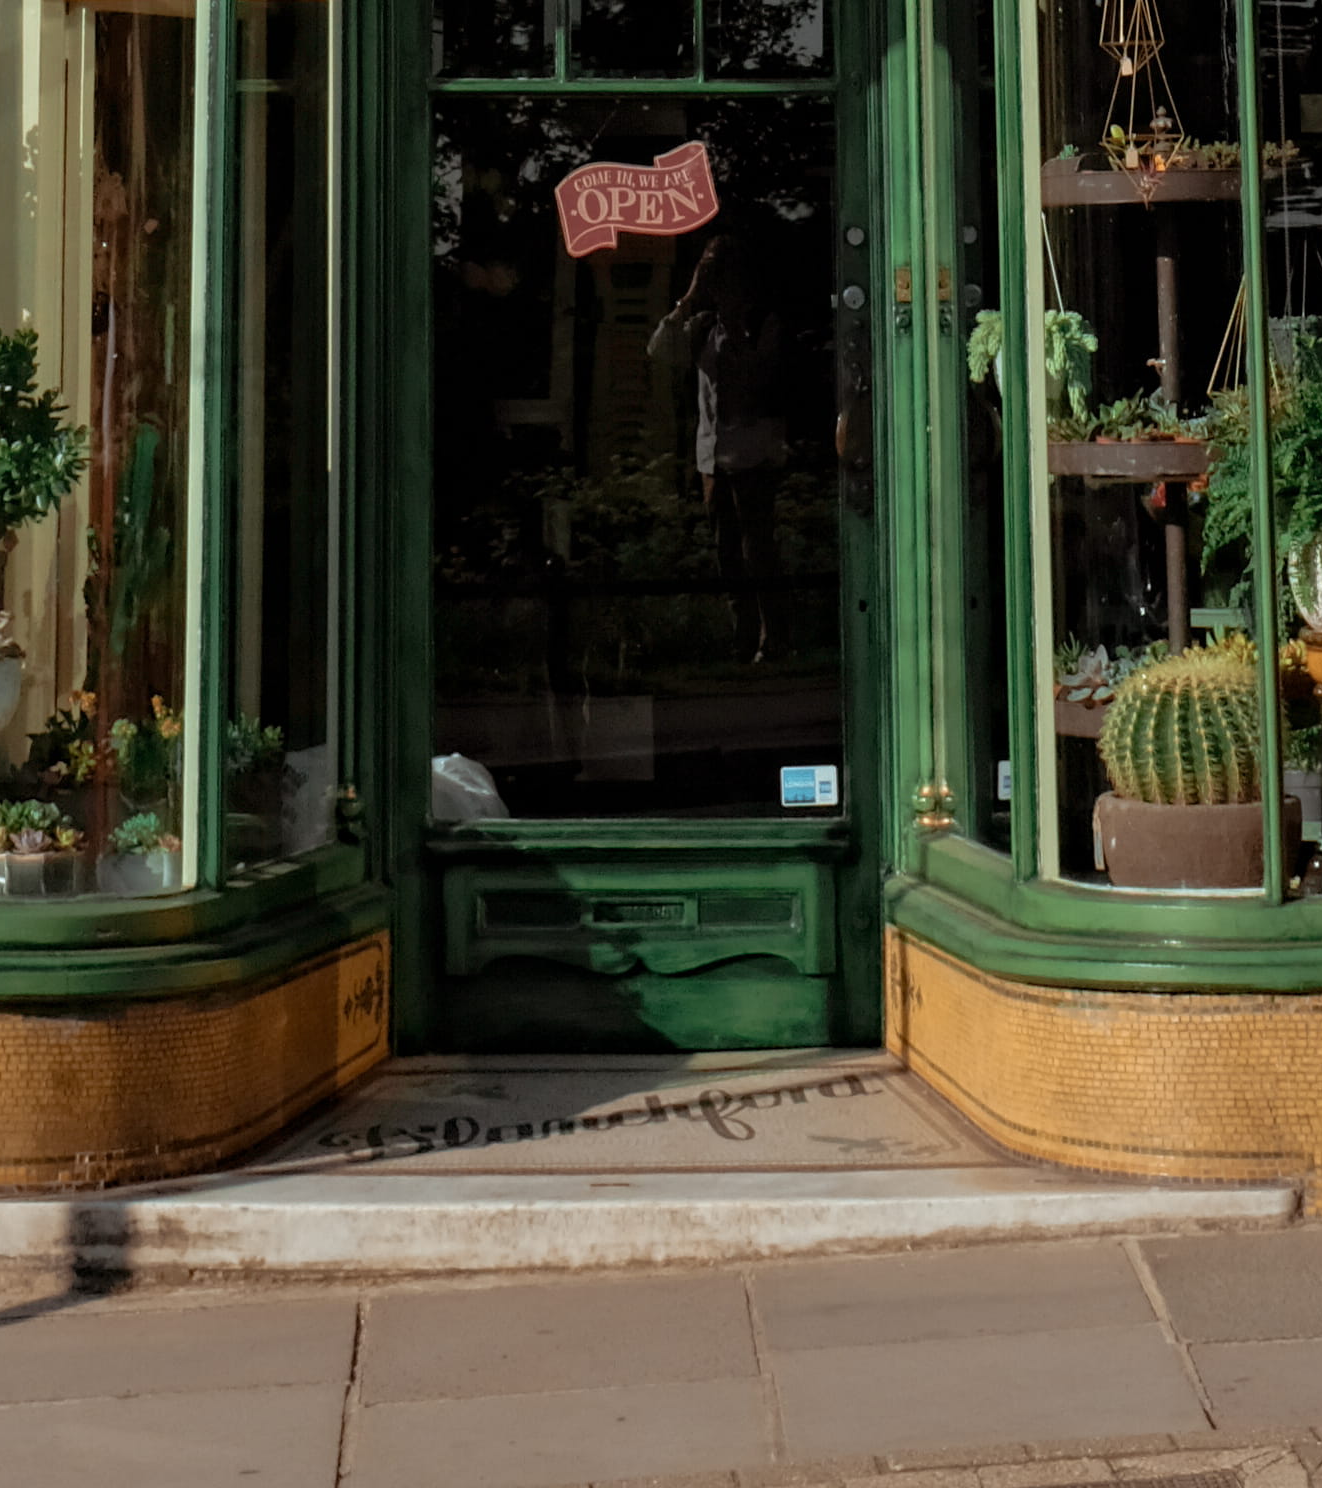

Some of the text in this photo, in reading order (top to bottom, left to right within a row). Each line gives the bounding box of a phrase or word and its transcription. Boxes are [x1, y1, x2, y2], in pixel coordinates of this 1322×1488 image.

[574, 170, 612, 192] COME
[639, 174, 659, 188] WE
[664, 168, 692, 187] ARE
[577, 181, 700, 224] OPEN
